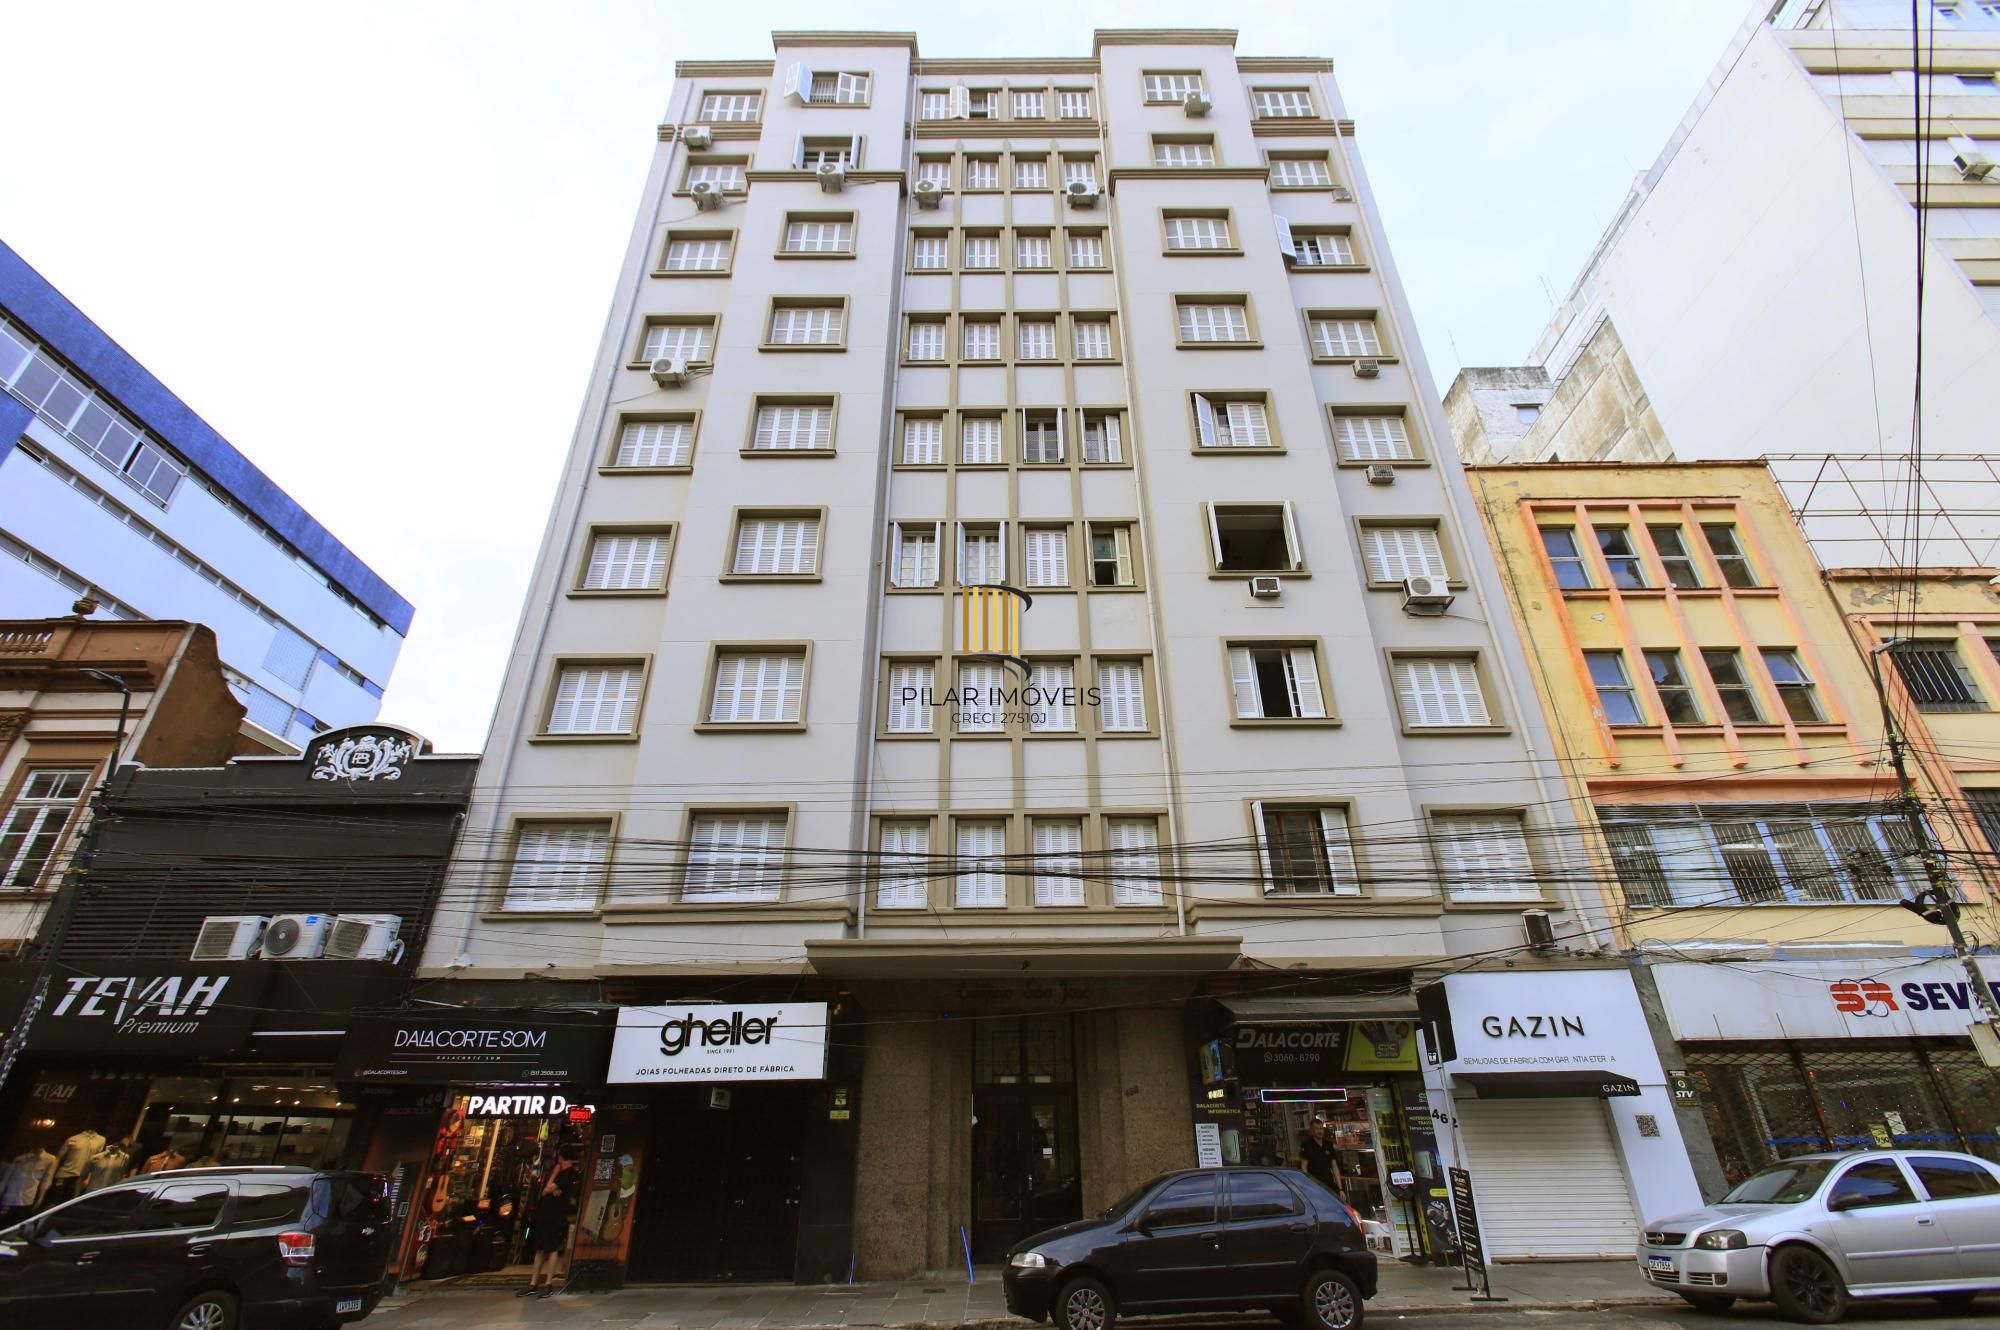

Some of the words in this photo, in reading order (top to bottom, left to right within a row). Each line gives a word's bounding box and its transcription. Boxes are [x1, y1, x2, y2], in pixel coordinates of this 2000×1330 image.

[52, 976, 230, 1024] TEVAH
[1901, 982, 2000, 1011] SEV
[118, 1018, 200, 1034] Premium
[659, 1011, 778, 1057] gheller
[1482, 1015, 1585, 1038] GAZIN
[394, 1030, 501, 1048] DALACORTE
[500, 1030, 547, 1048] SOM
[1235, 1028, 1341, 1049] DALACORTE
[1538, 1056, 1553, 1064] COM
[635, 1067, 660, 1076] JOIAS
[662, 1066, 712, 1075] FOLHEADAS
[714, 1066, 744, 1074] DIRETO
[746, 1065, 757, 1073] DE
[759, 1064, 795, 1073] FÁBRICA
[1602, 1084, 1636, 1093] GAZIN
[1675, 1090, 1693, 1098] STV
[468, 1095, 546, 1115] PARTIR
